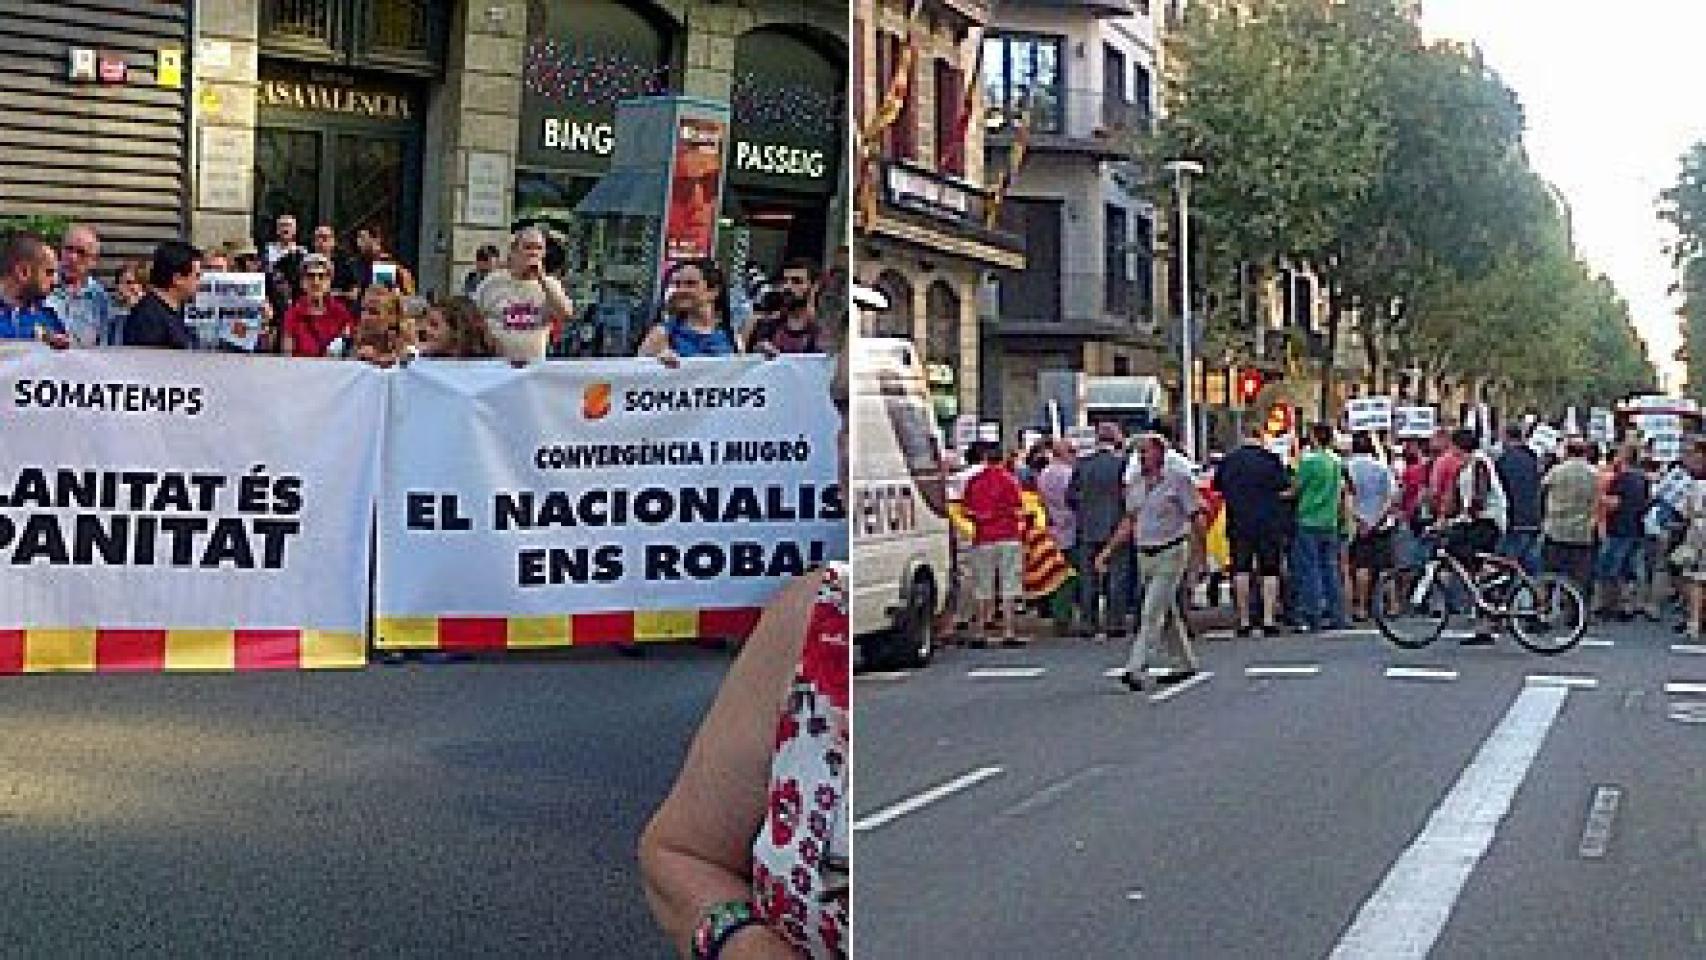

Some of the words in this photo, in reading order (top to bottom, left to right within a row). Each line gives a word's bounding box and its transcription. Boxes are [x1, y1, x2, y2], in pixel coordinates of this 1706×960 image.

[545, 118, 614, 154] BING
[737, 141, 824, 177] PASSEIG
[15, 380, 203, 414] SOMATEMPS
[625, 387, 766, 412] SOMATEMPS
[238, 464, 303, 514] ÉS
[407, 492, 472, 530] EL
[495, 484, 846, 530] NACIONALIS
[518, 546, 623, 585] ENS
